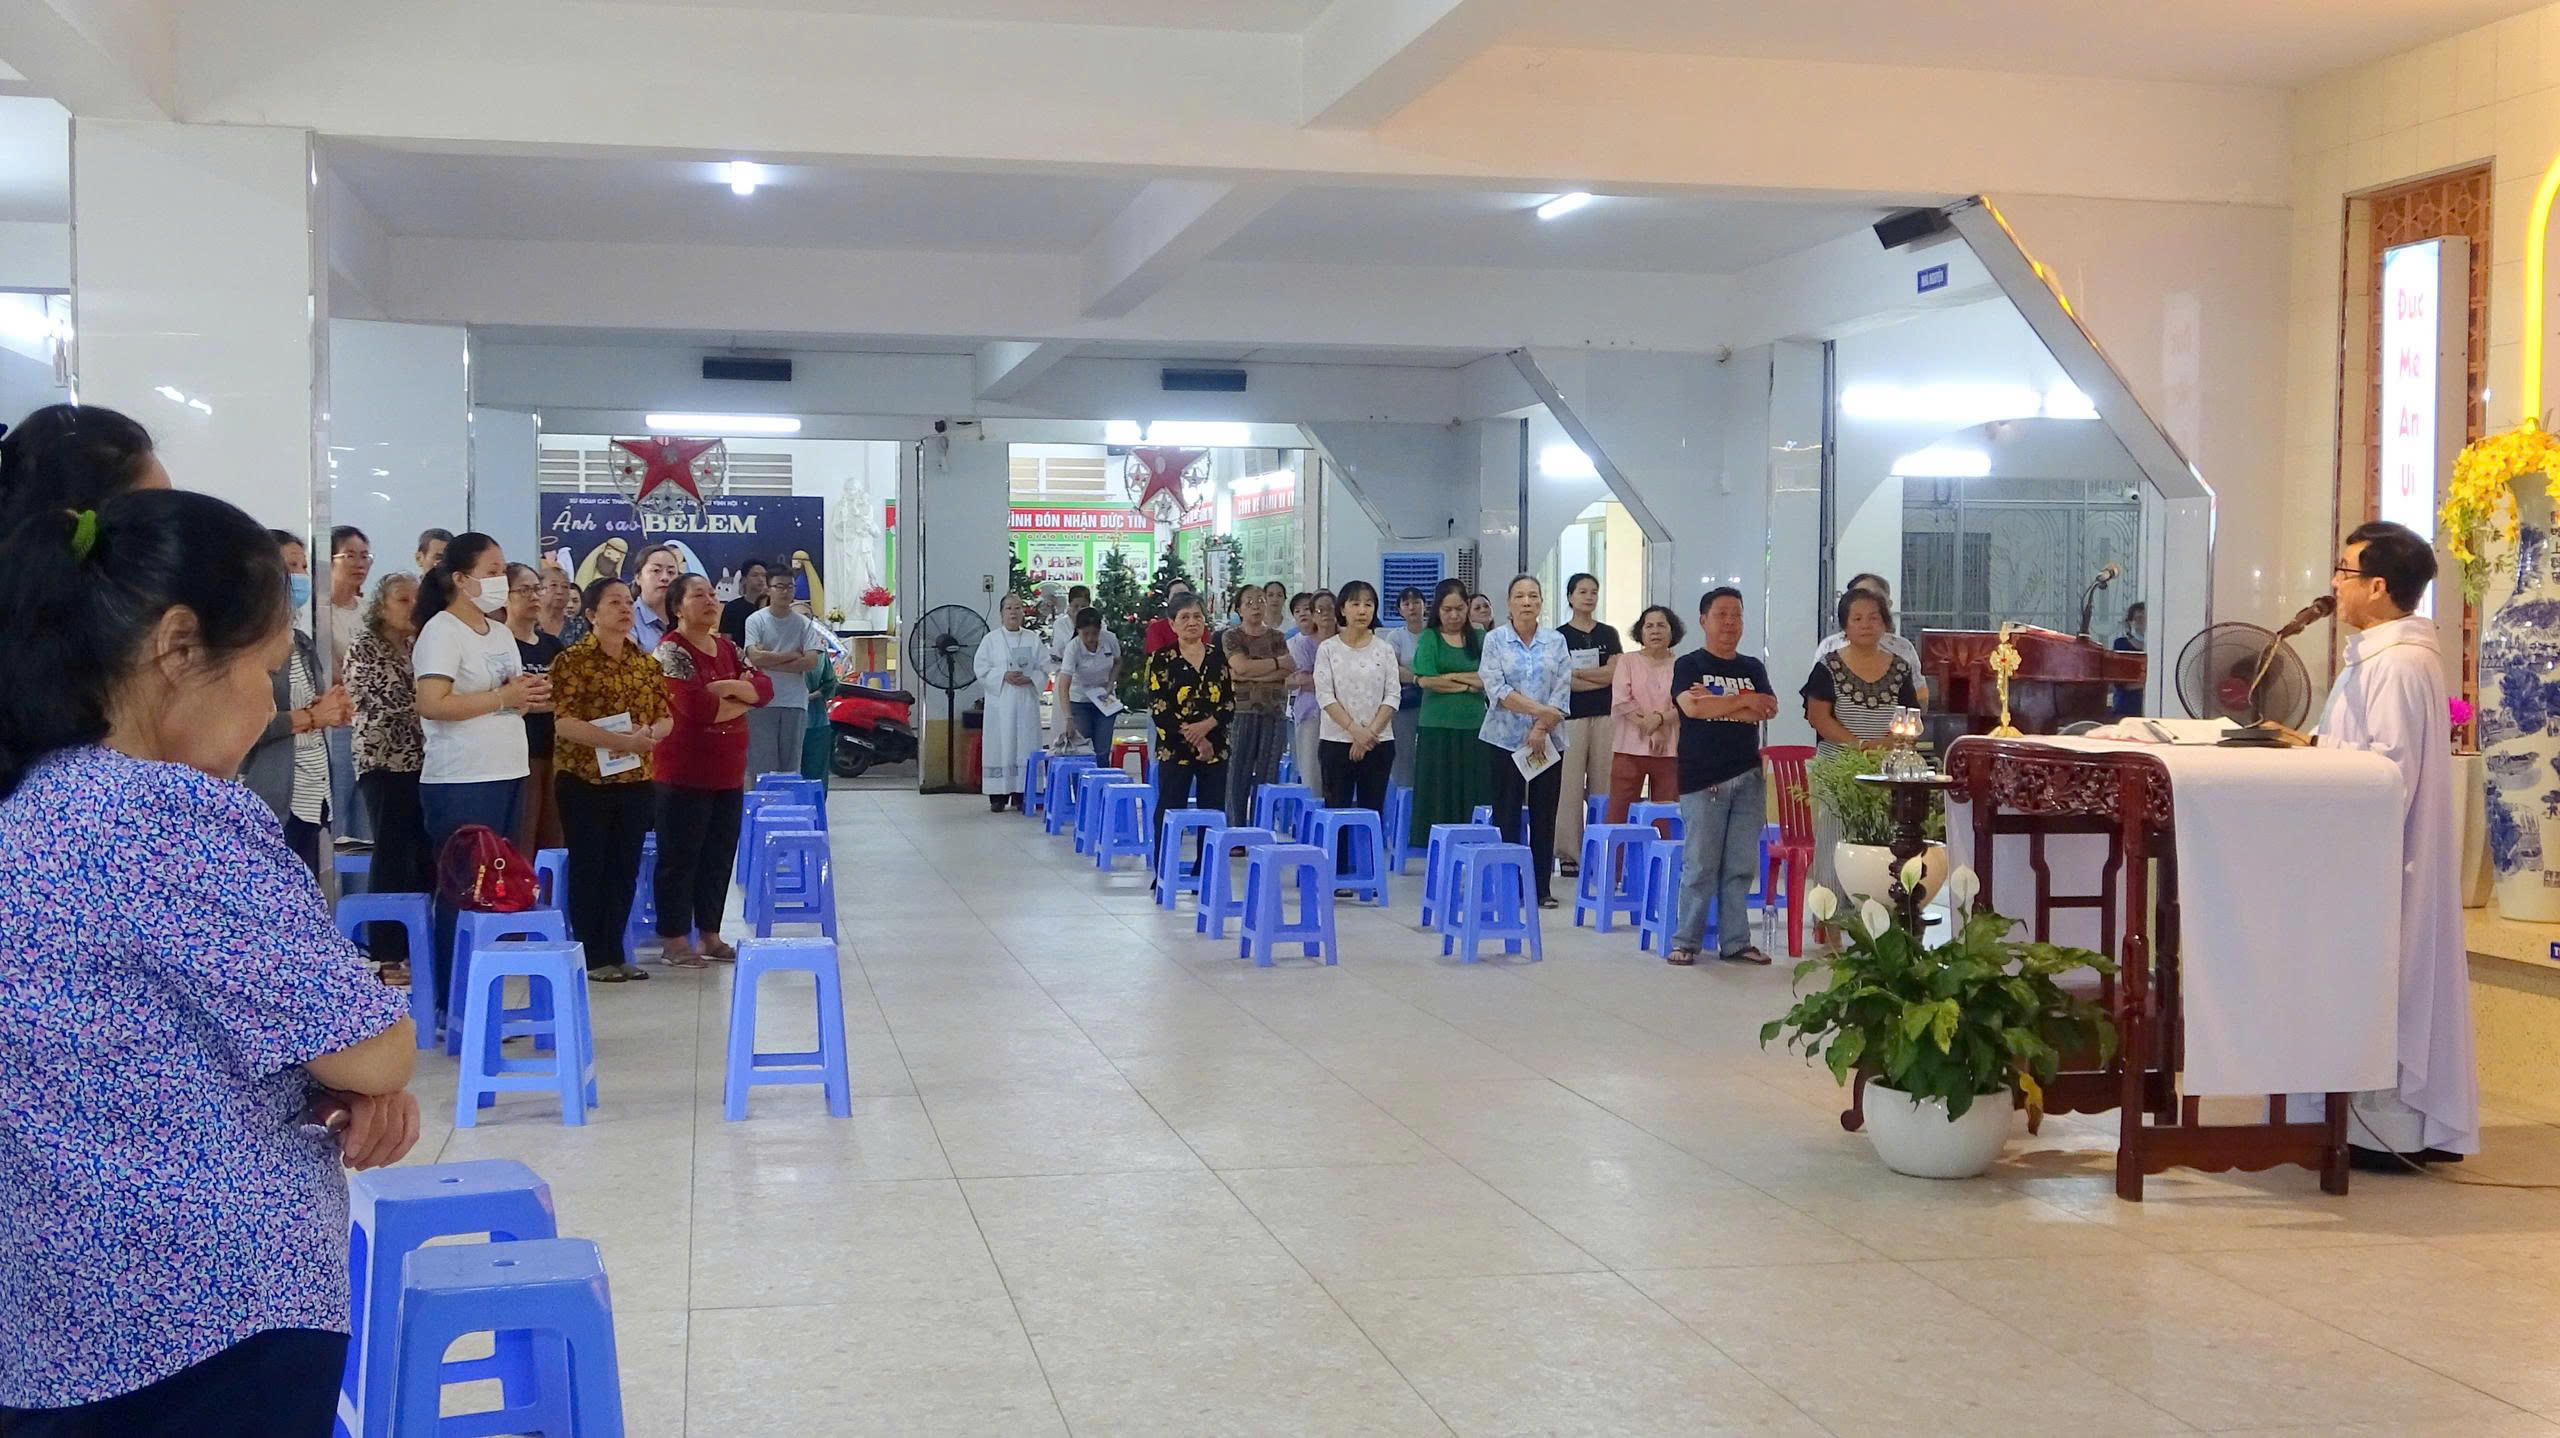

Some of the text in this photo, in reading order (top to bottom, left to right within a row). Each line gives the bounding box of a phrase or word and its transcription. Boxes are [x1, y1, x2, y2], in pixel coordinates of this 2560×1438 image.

[2399, 404, 2419, 437] An
[552, 501, 597, 532] Ánh
[605, 520, 641, 531] sao
[1035, 511, 1060, 528] ĐÓN
[1064, 511, 1096, 530] NHẬN
[1100, 511, 1124, 528] ĐỨC
[1128, 514, 1147, 528] TIN
[1703, 674, 1756, 691] PARIS
